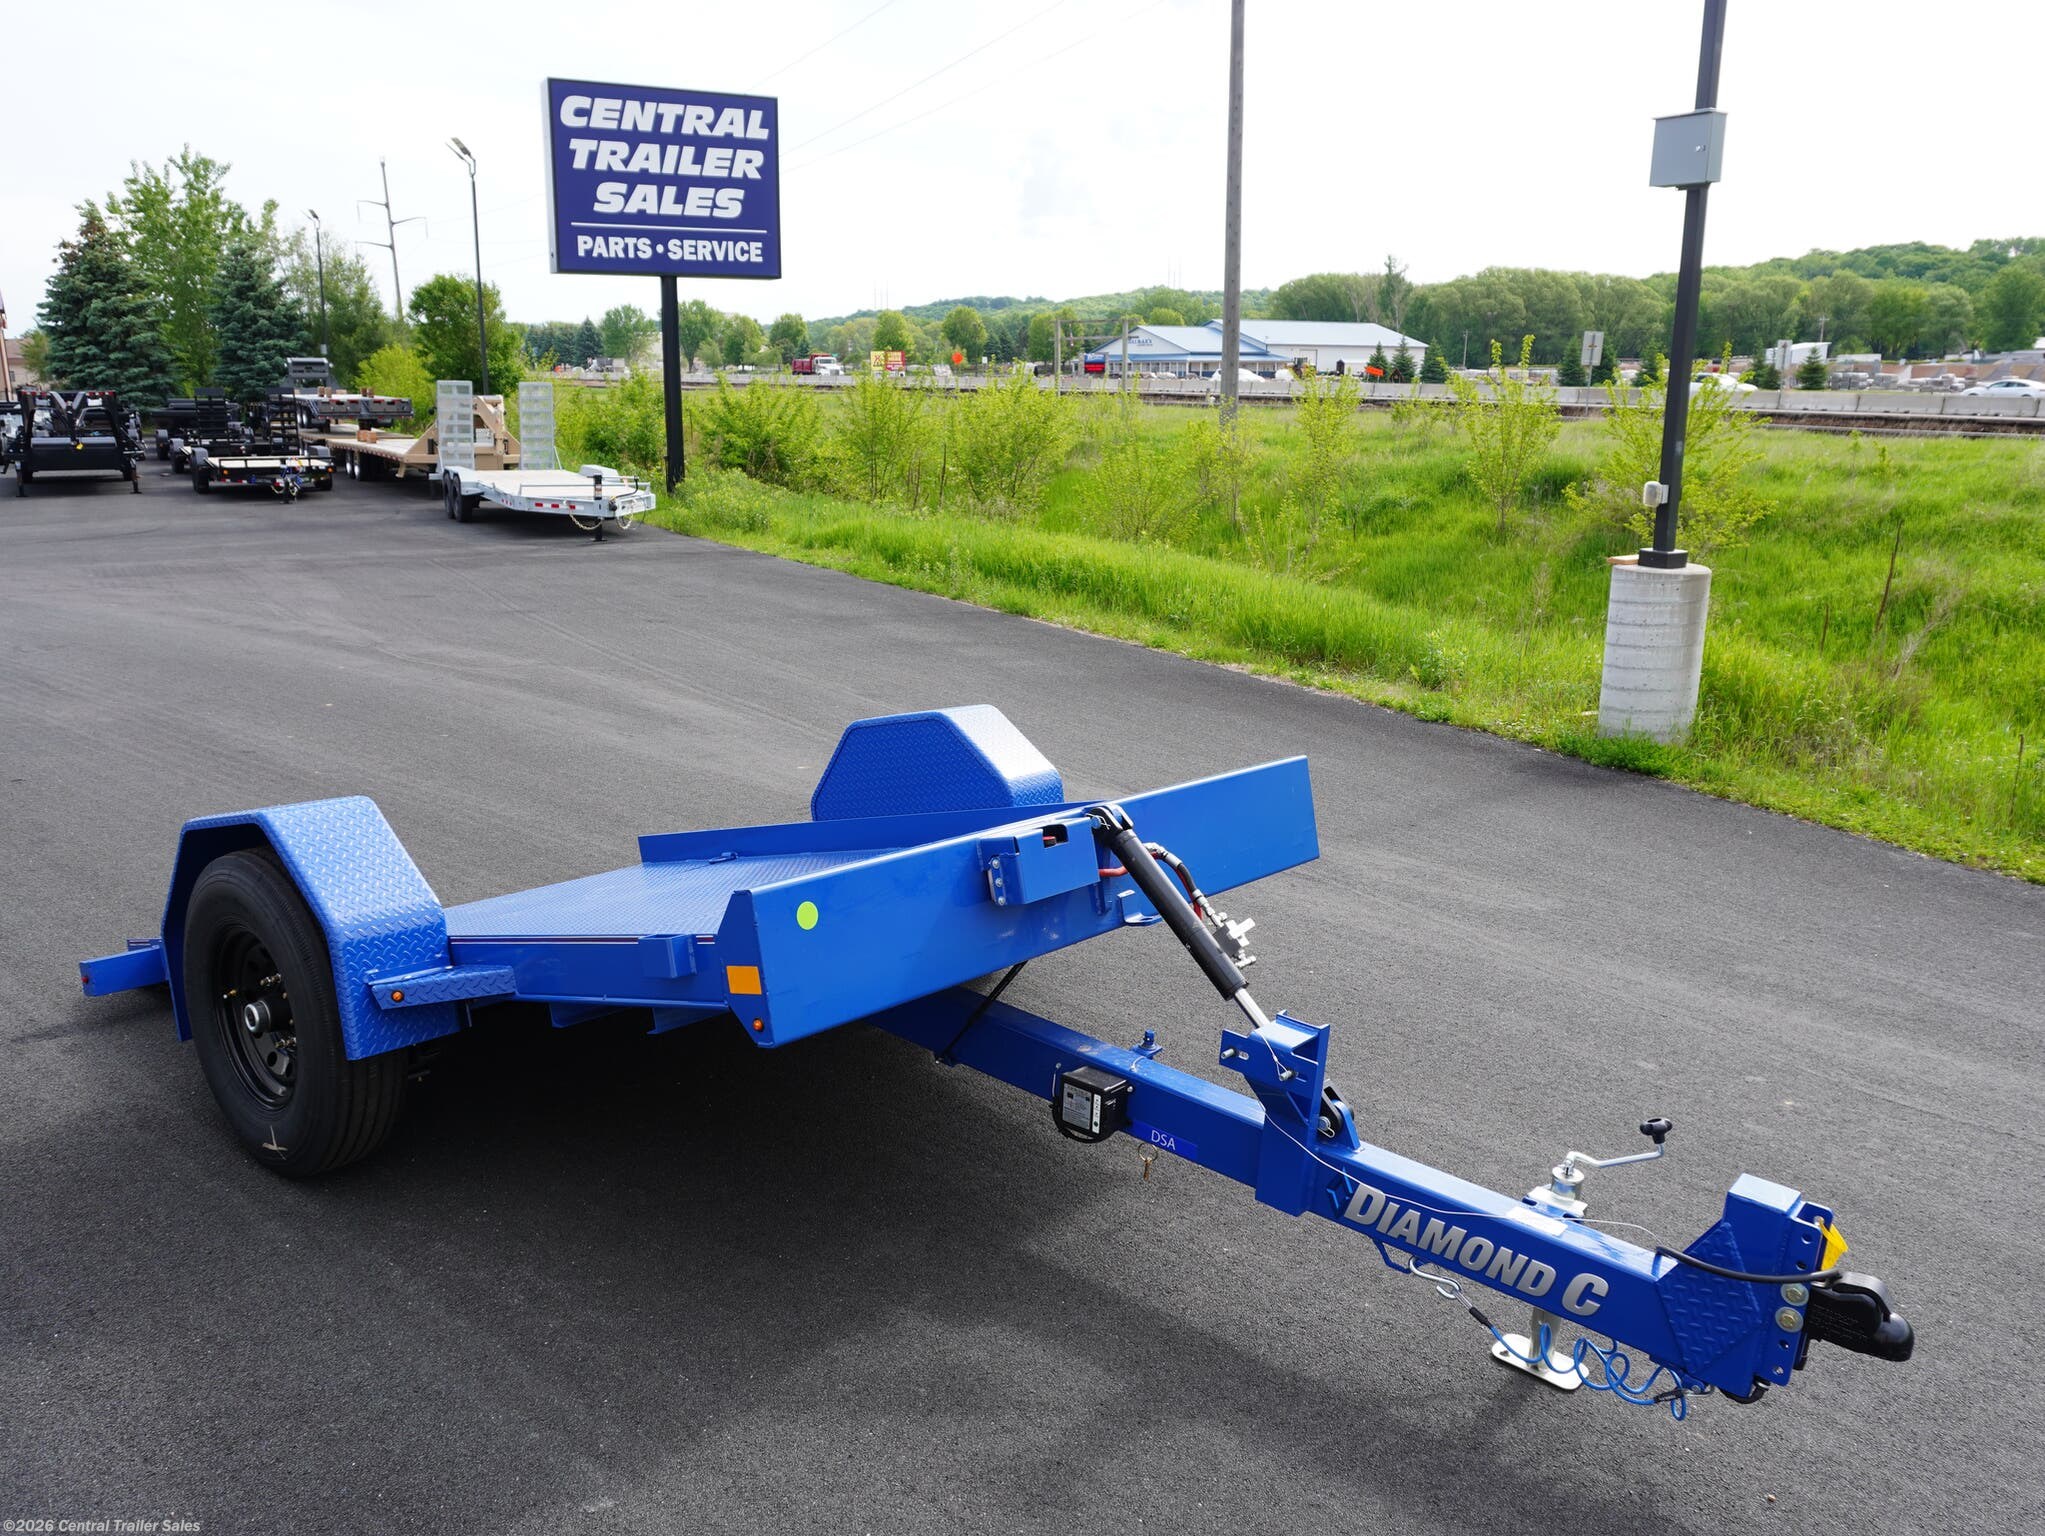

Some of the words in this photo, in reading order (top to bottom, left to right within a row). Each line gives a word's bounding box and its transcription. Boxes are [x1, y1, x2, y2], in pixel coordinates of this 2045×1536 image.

[560, 95, 769, 139] CENTRAL
[569, 138, 764, 179] TRAILER
[593, 181, 745, 218] SALES
[577, 235, 652, 259] PARTS
[667, 238, 763, 262] SERVICE
[1151, 1129, 1175, 1150] DSA
[1344, 1183, 1557, 1297] DIAMOND
[1561, 1273, 1609, 1317] C
